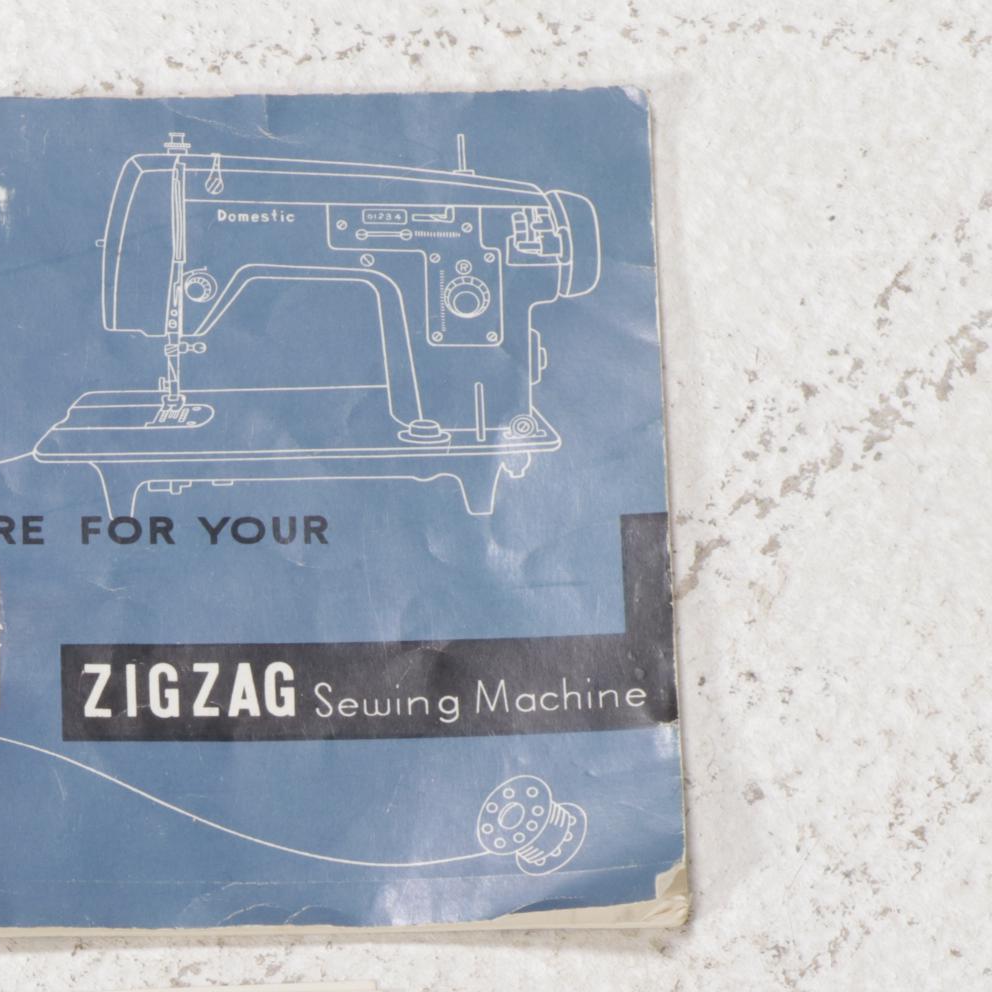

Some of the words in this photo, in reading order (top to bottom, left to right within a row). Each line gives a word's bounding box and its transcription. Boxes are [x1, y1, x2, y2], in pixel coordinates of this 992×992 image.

[218, 209, 295, 223] Domestic
[81, 515, 174, 546] FOR
[198, 515, 329, 546] YOUR
[83, 661, 295, 719] ZIGZAG
[315, 680, 459, 722] Sewing
[475, 678, 647, 713] Machine
